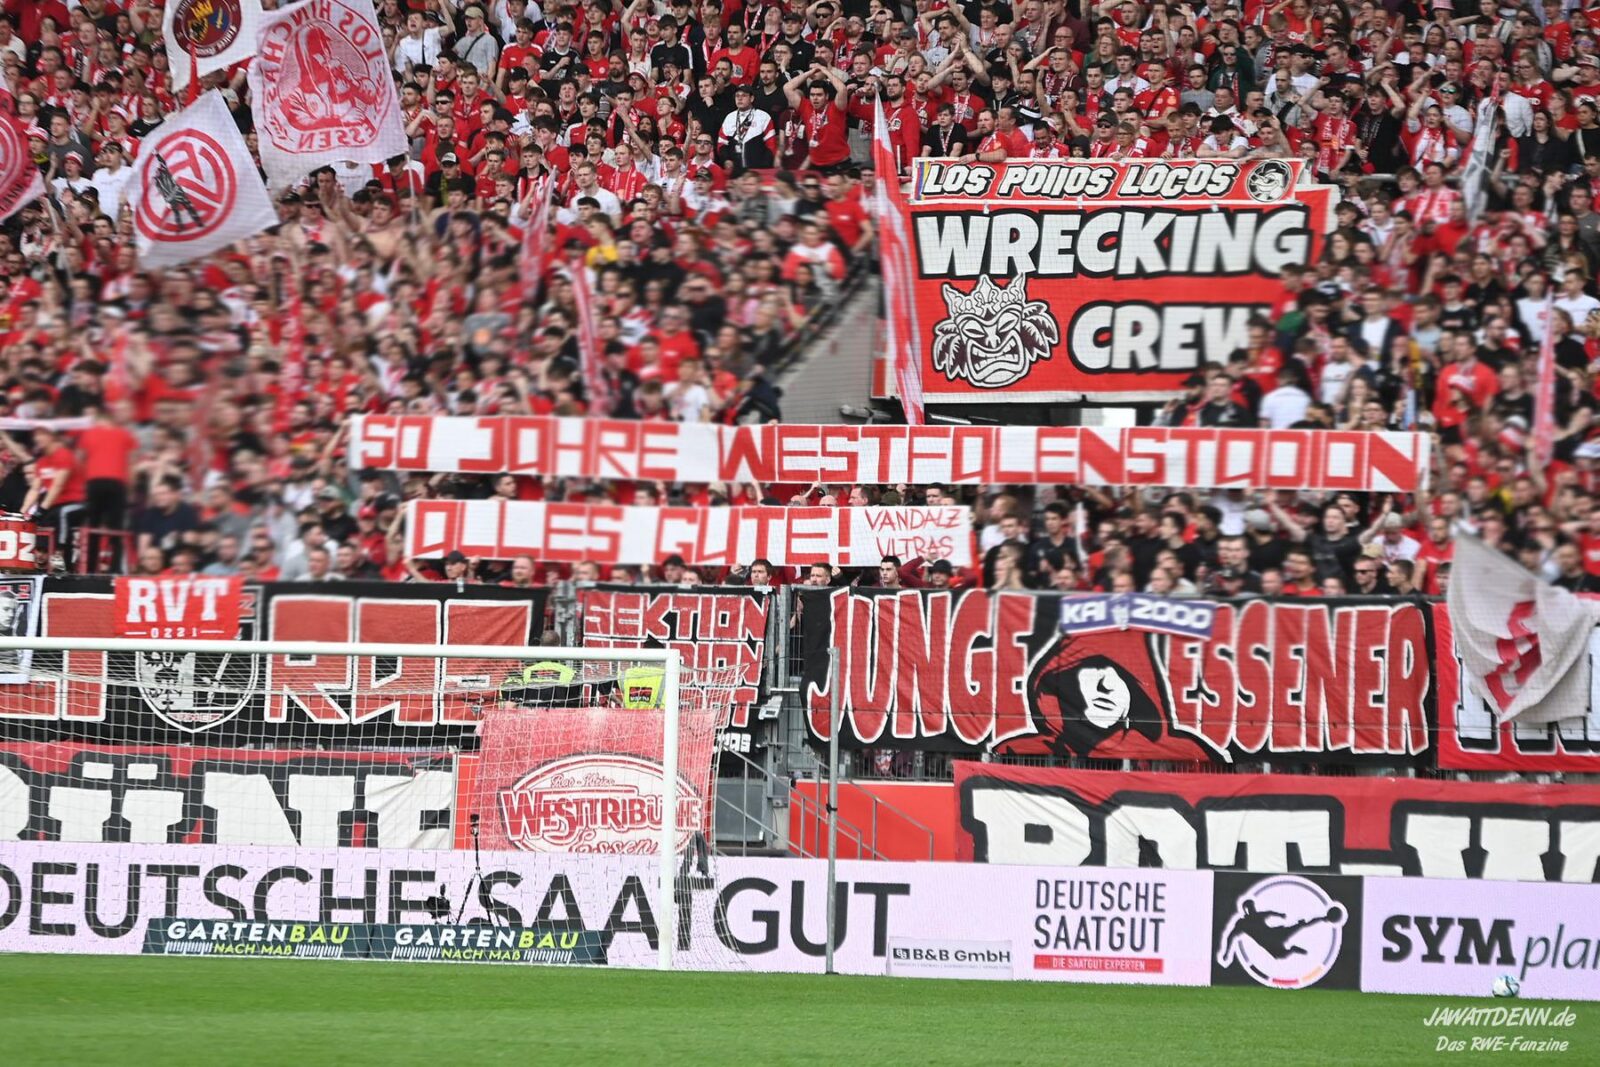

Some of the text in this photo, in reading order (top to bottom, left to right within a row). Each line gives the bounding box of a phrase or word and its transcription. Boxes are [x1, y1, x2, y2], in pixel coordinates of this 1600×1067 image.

[922, 163, 995, 195] LOS
[1118, 164, 1238, 196] LOCOS
[916, 207, 1311, 277] WRECKING
[458, 416, 679, 480] JAHRE
[717, 422, 1420, 492] WESTFALENSTADION
[412, 500, 852, 566] ALLES GUTE!
[864, 508, 961, 531] VANDALZ
[876, 535, 954, 559] ULTRAS
[126, 578, 230, 623] RVT
[583, 594, 768, 640] SEKTION
[1062, 597, 1213, 630] KAI 2000
[150, 626, 198, 639] 0221
[806, 588, 1039, 748] JUNGE
[1160, 600, 1432, 762] ESSENER
[1036, 879, 1167, 914] DEUTSCHE
[477, 869, 911, 958] SAATGUT
[166, 920, 350, 945] GARTENBAU
[213, 942, 257, 955] NACH
[394, 926, 580, 951] GARTENBAU
[1033, 914, 1166, 953] SAATGUT
[441, 948, 483, 961] NACH
[913, 948, 1011, 963] B&B GmbH
[1052, 957, 1146, 972] DIE SAATGUT EXPERTEN
